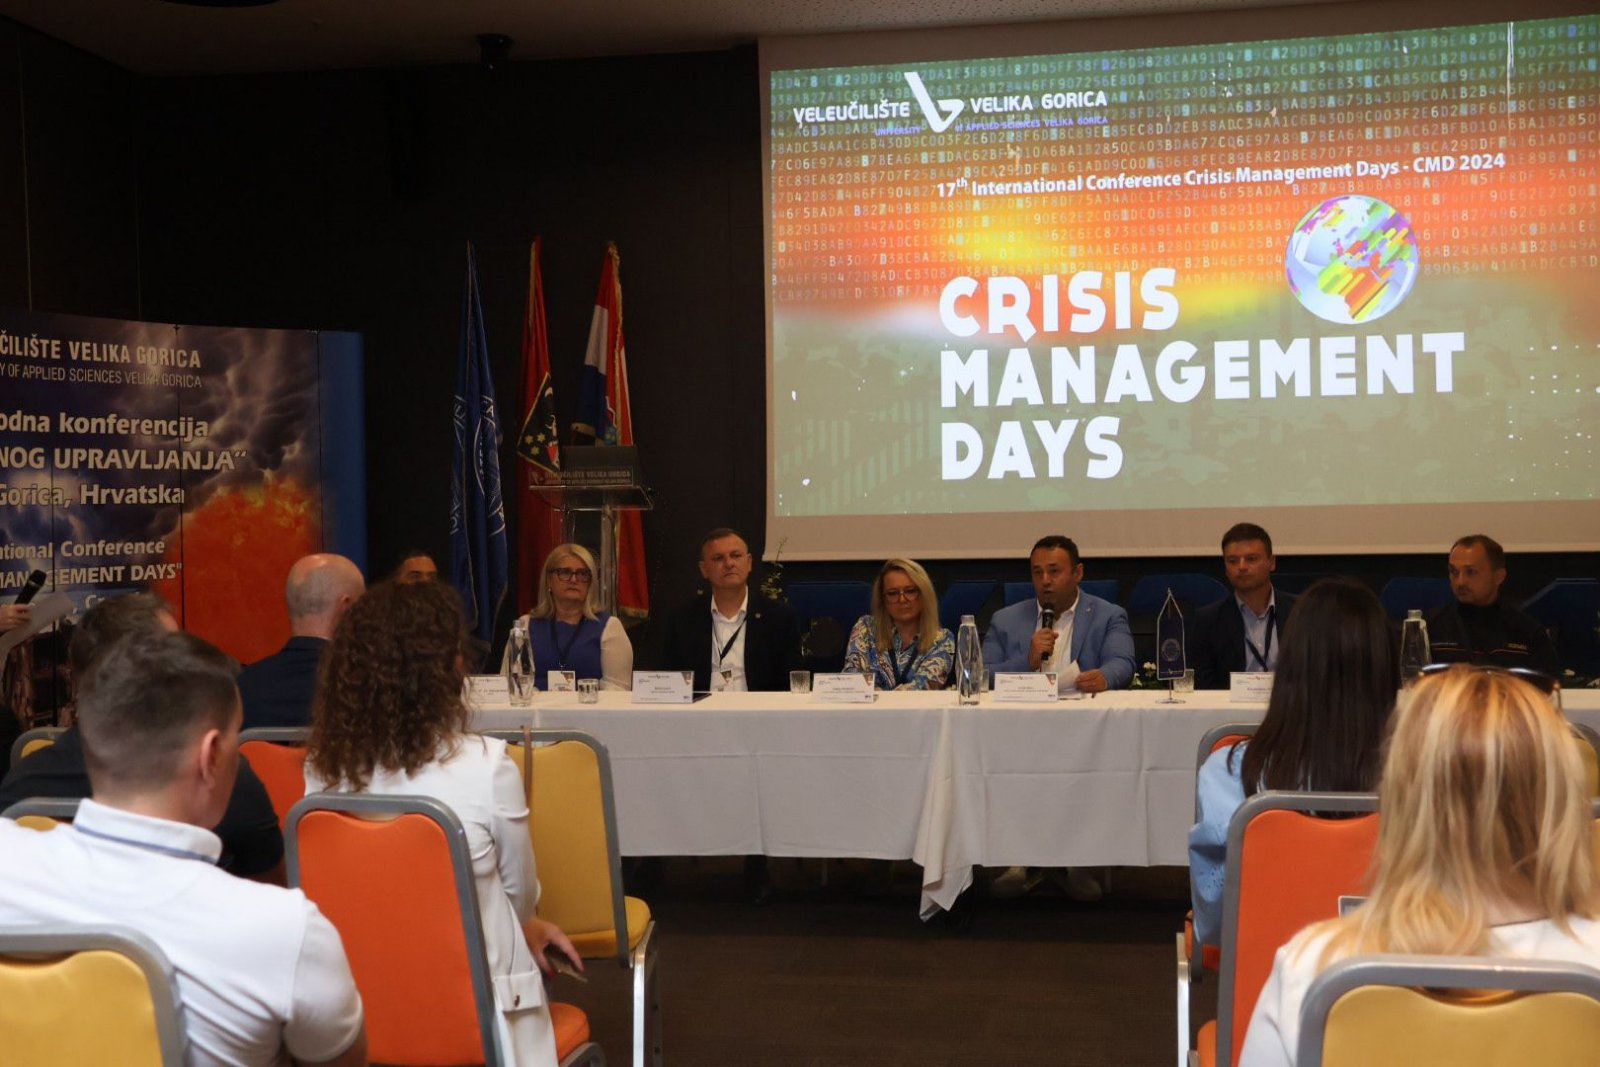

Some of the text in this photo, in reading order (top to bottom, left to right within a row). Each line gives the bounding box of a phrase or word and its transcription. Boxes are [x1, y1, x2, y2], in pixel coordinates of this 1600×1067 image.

[793, 99, 910, 123] VELEUČILIŠTE
[970, 95, 1033, 114] VELIKA
[1041, 90, 1108, 110] GORICA
[1044, 118, 1073, 127] VELIKA
[1077, 117, 1108, 126] GORICA
[972, 175, 1082, 196] International
[1086, 172, 1182, 192] Conference
[1185, 166, 1231, 185] Crisis
[1236, 159, 1352, 184] Management
[1356, 160, 1399, 178] Days
[1413, 155, 1455, 173] CMD
[1460, 153, 1505, 169] 2024
[939, 267, 1180, 342] CRISIS
[69, 341, 131, 363] VELIKA
[136, 346, 201, 368] GORICA
[940, 332, 1465, 408] MANAGEMENT
[8, 363, 20, 377] OF
[22, 364, 66, 381] APPLIED
[69, 368, 122, 384] SCIENCES
[124, 371, 159, 385] VELIKA
[162, 373, 201, 388] GORICA
[59, 412, 209, 443] konferencija
[941, 416, 1124, 480] DAYS
[80, 483, 185, 505] Hrvatska
[60, 538, 166, 557] Conference
